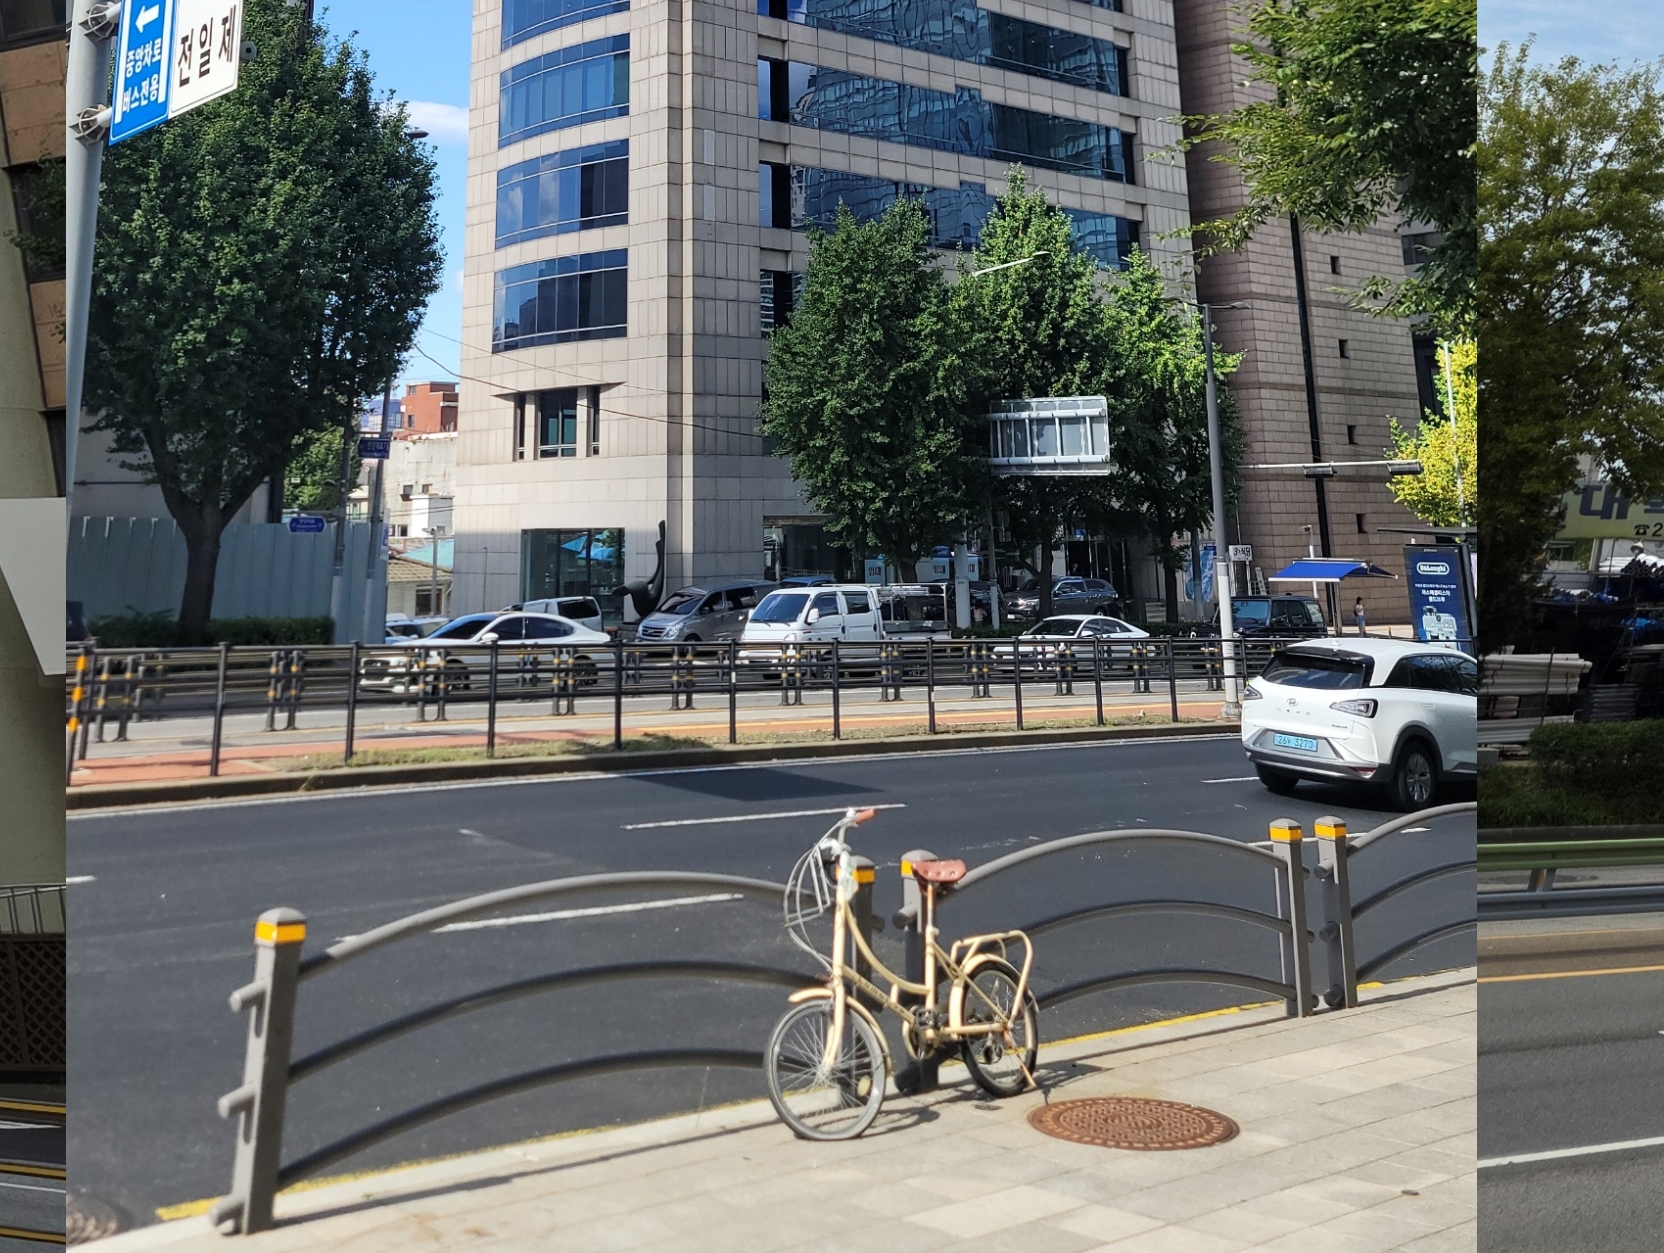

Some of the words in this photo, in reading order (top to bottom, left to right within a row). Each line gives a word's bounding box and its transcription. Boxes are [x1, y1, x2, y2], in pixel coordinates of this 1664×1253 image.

[125, 37, 163, 78] 중앙차로
[177, 4, 237, 88] 전일제
[121, 73, 160, 113] 버스전용
